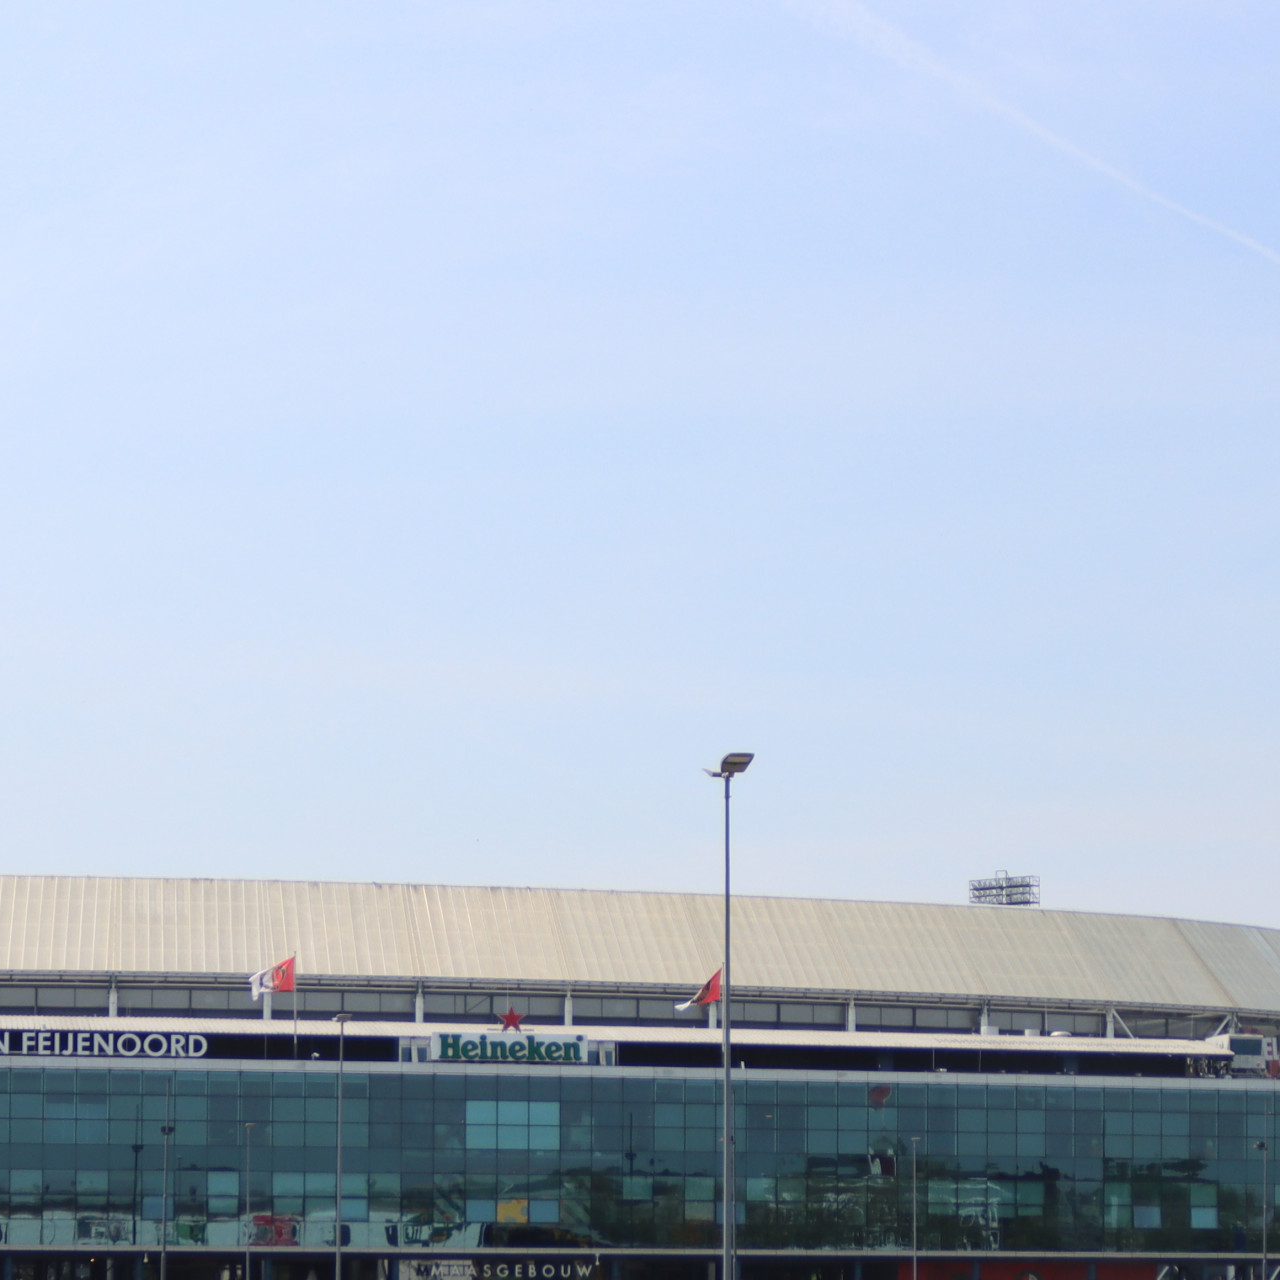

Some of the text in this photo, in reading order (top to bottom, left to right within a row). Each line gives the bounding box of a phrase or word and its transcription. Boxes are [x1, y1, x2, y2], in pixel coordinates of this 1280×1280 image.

[22, 1032, 208, 1057] FEIJENOORD
[439, 1034, 583, 1061] Heineken
[430, 1264, 592, 1278] MAASGEBOUW
